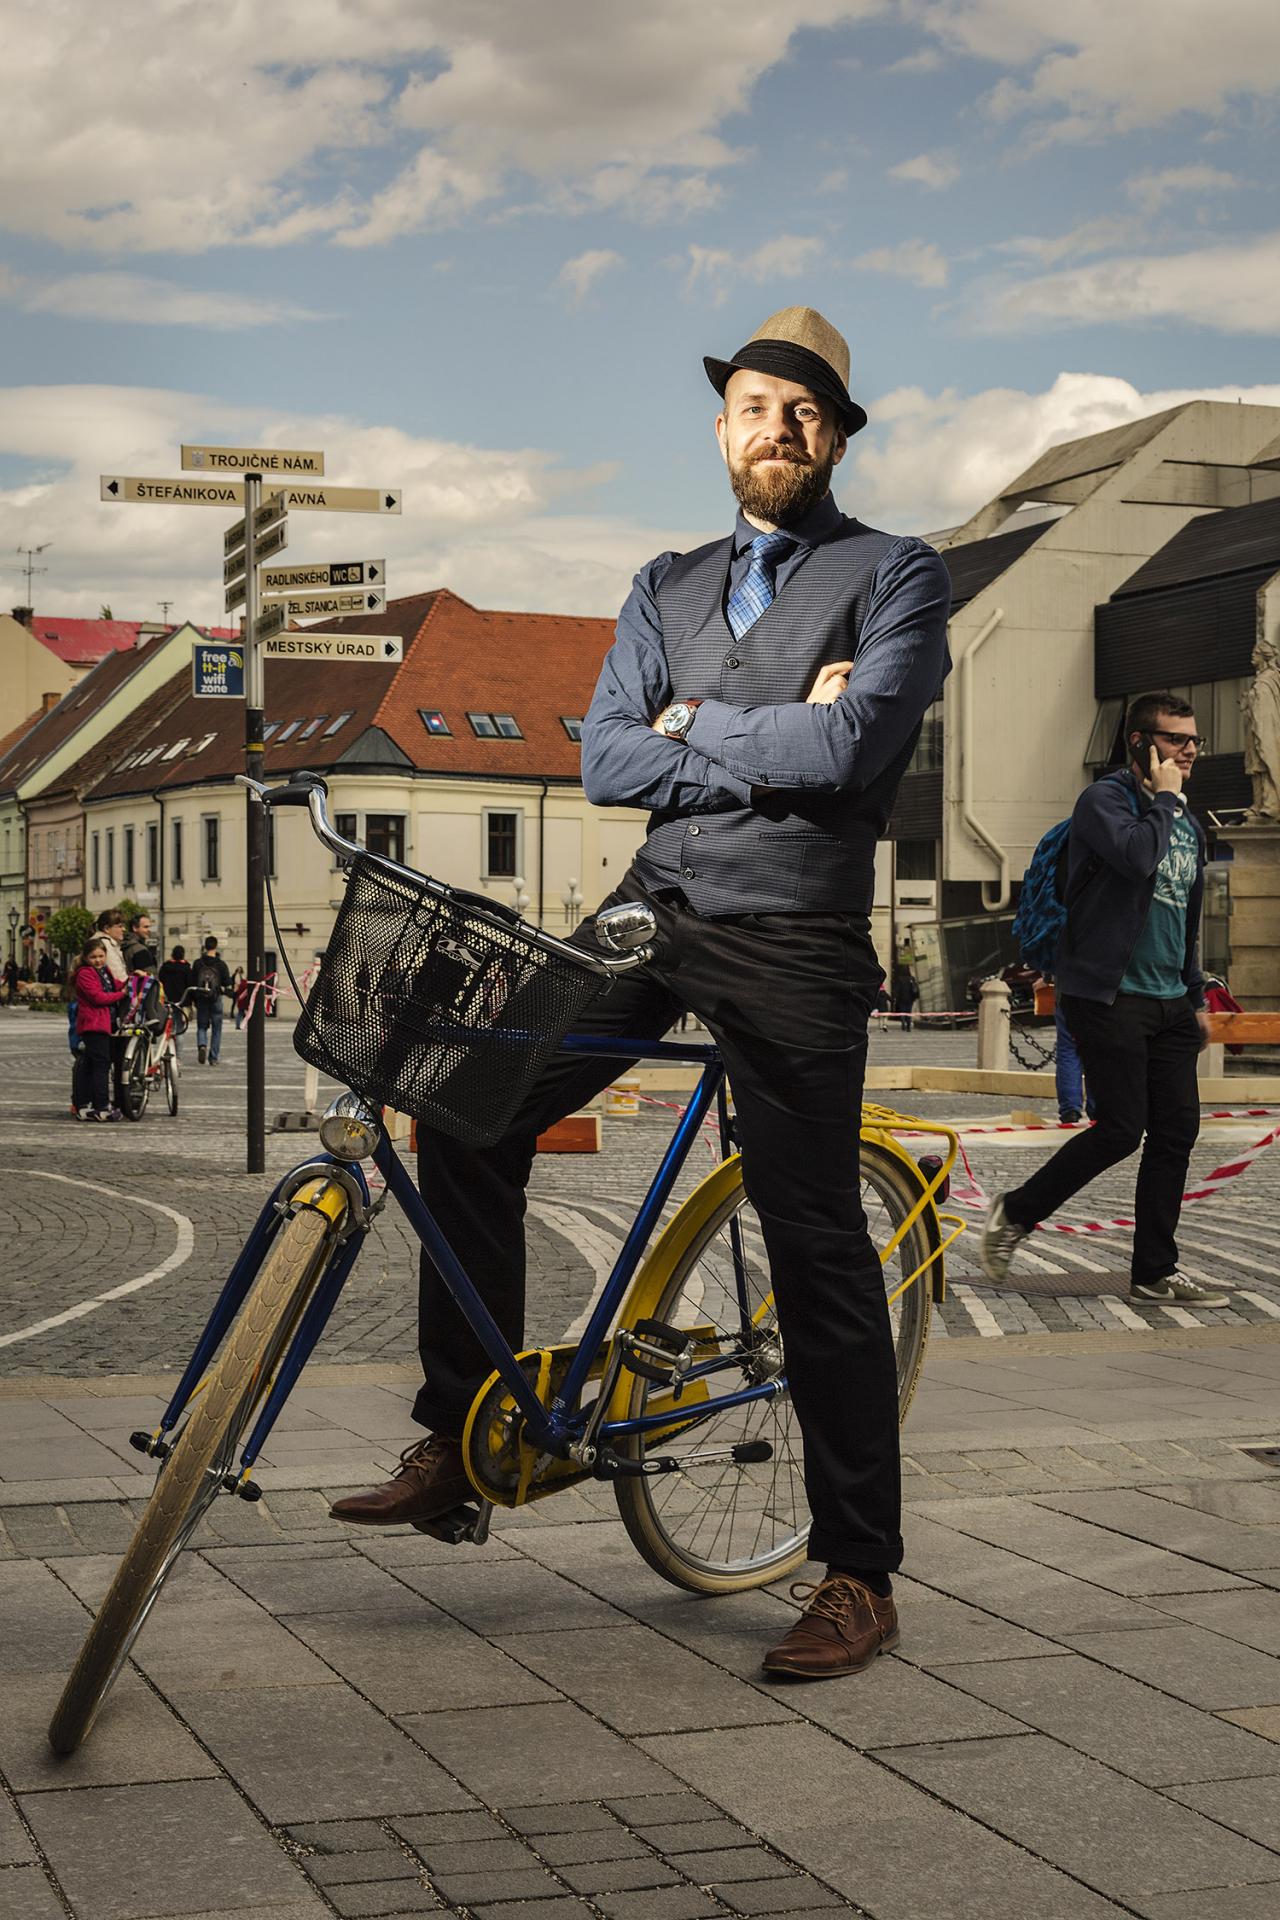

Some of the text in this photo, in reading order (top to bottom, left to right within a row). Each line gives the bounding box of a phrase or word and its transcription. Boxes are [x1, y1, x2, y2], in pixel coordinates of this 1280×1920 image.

[209, 453, 318, 470] TROJIČNÉ NÁM.
[137, 482, 236, 501] ŠTEFÁNIKOVA
[271, 491, 326, 506] AVNÁ
[266, 569, 348, 587] RADLINSKÉHO WC
[266, 640, 375, 656] MESTSKÝ ÚRAD
[202, 650, 227, 663] free
[202, 662, 227, 673] tt-it
[203, 673, 226, 685] wifi
[201, 684, 228, 693] zone
